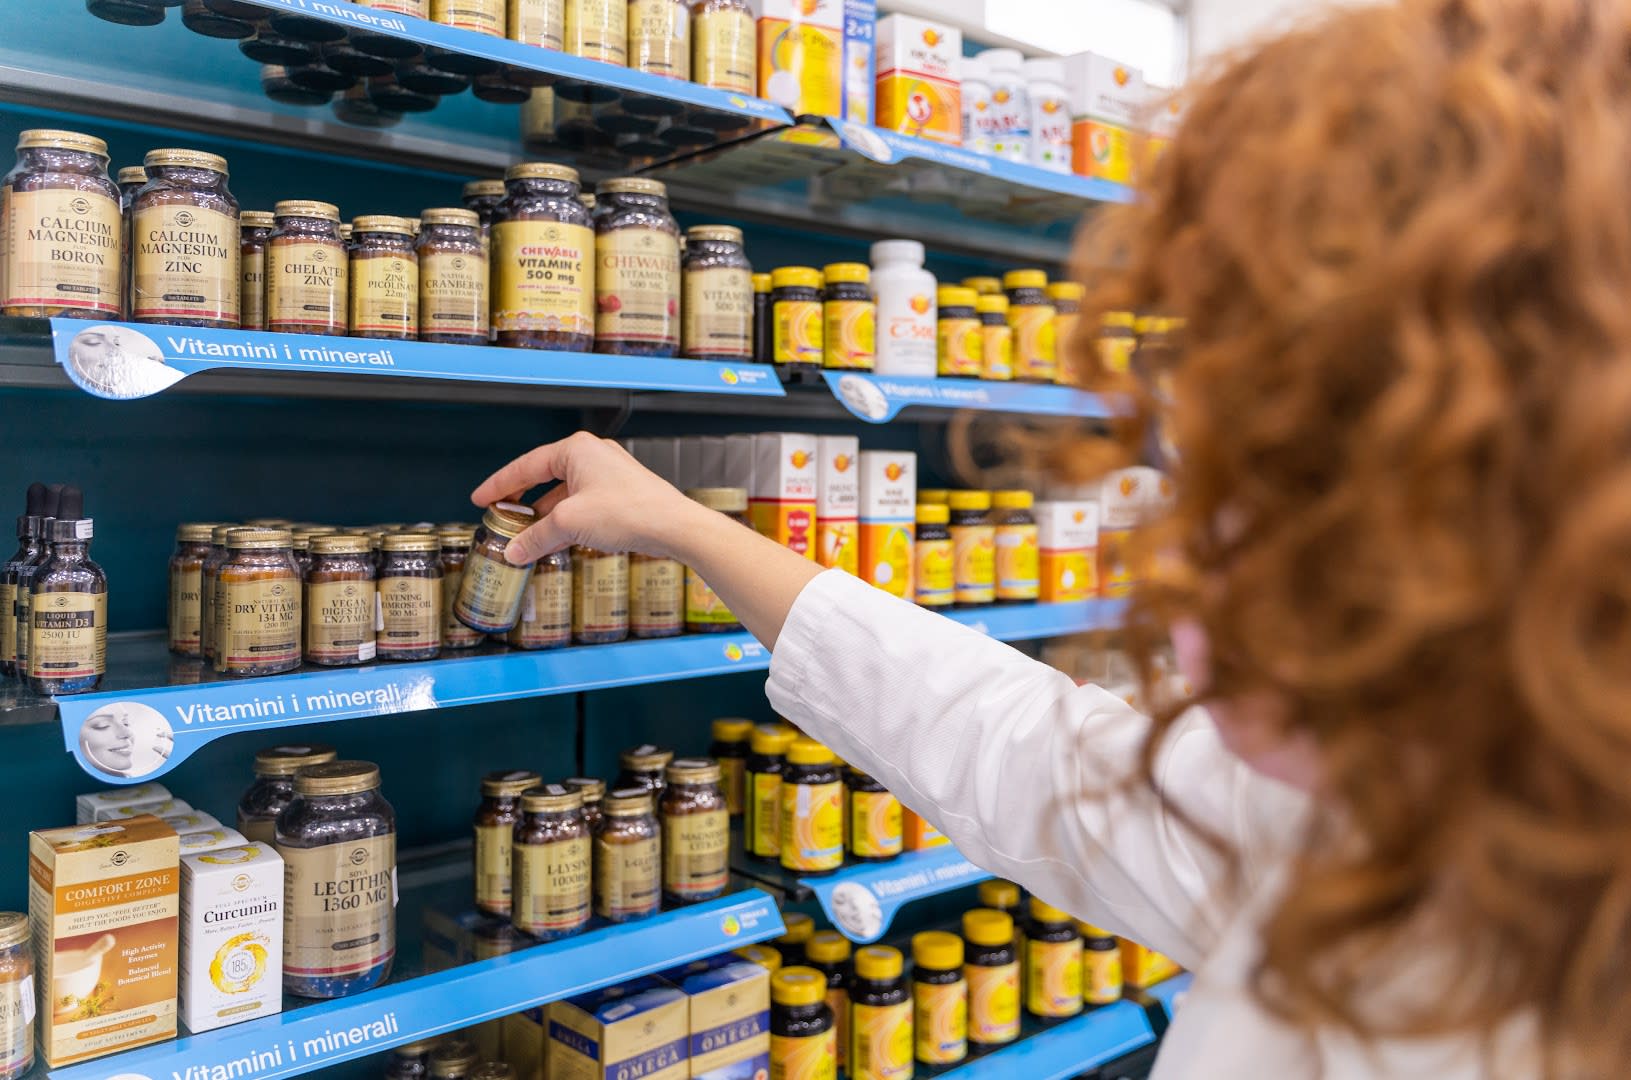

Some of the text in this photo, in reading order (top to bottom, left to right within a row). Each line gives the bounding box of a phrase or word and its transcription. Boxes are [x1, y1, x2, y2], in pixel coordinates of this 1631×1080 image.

[313, 1, 407, 32] minerali
[40, 217, 112, 235] CALCIUM
[28, 229, 118, 249] MAGNESIUM
[150, 231, 218, 245] CALCIUM
[51, 249, 105, 265] BORON
[141, 243, 228, 259] MAGNESIUM
[521, 247, 578, 258] CHEWABLE
[165, 261, 202, 273] ZINC
[285, 264, 345, 278] CHELATED
[518, 259, 581, 272] VITAMIN C
[304, 276, 333, 287] ZINC
[385, 273, 405, 282] ZINC
[527, 270, 575, 284] 500 mg
[168, 336, 395, 366] Vitamini i minerali
[235, 604, 257, 613] DRY
[332, 599, 366, 607] VEGAN
[258, 612, 293, 622] 134 MG
[324, 614, 371, 624] ENZYMES
[404, 609, 417, 617] MG
[36, 618, 89, 628] VITAMIN D3
[41, 631, 64, 639] 2500
[176, 683, 400, 725] Vitamini i minerali
[65, 874, 171, 903] COMFORT ZONE
[313, 870, 392, 897] LECITHIN
[74, 887, 163, 907] DIGESTIVE COMPLEX
[323, 887, 388, 912] 1360 MG
[73, 915, 95, 923] HELPS
[97, 912, 109, 920] YOU
[203, 900, 277, 923] Curcumin
[67, 907, 168, 931] ABOUT THE FOODS YOU ENJOY
[122, 942, 166, 957] High Activity
[128, 952, 158, 964] Enzymes
[128, 963, 160, 975] Balanced
[118, 968, 171, 986] Botanical Blend
[701, 1021, 761, 1051] OMEGA
[172, 1012, 399, 1080] Vitamini i minerali
[616, 1049, 681, 1080] OMEGA
